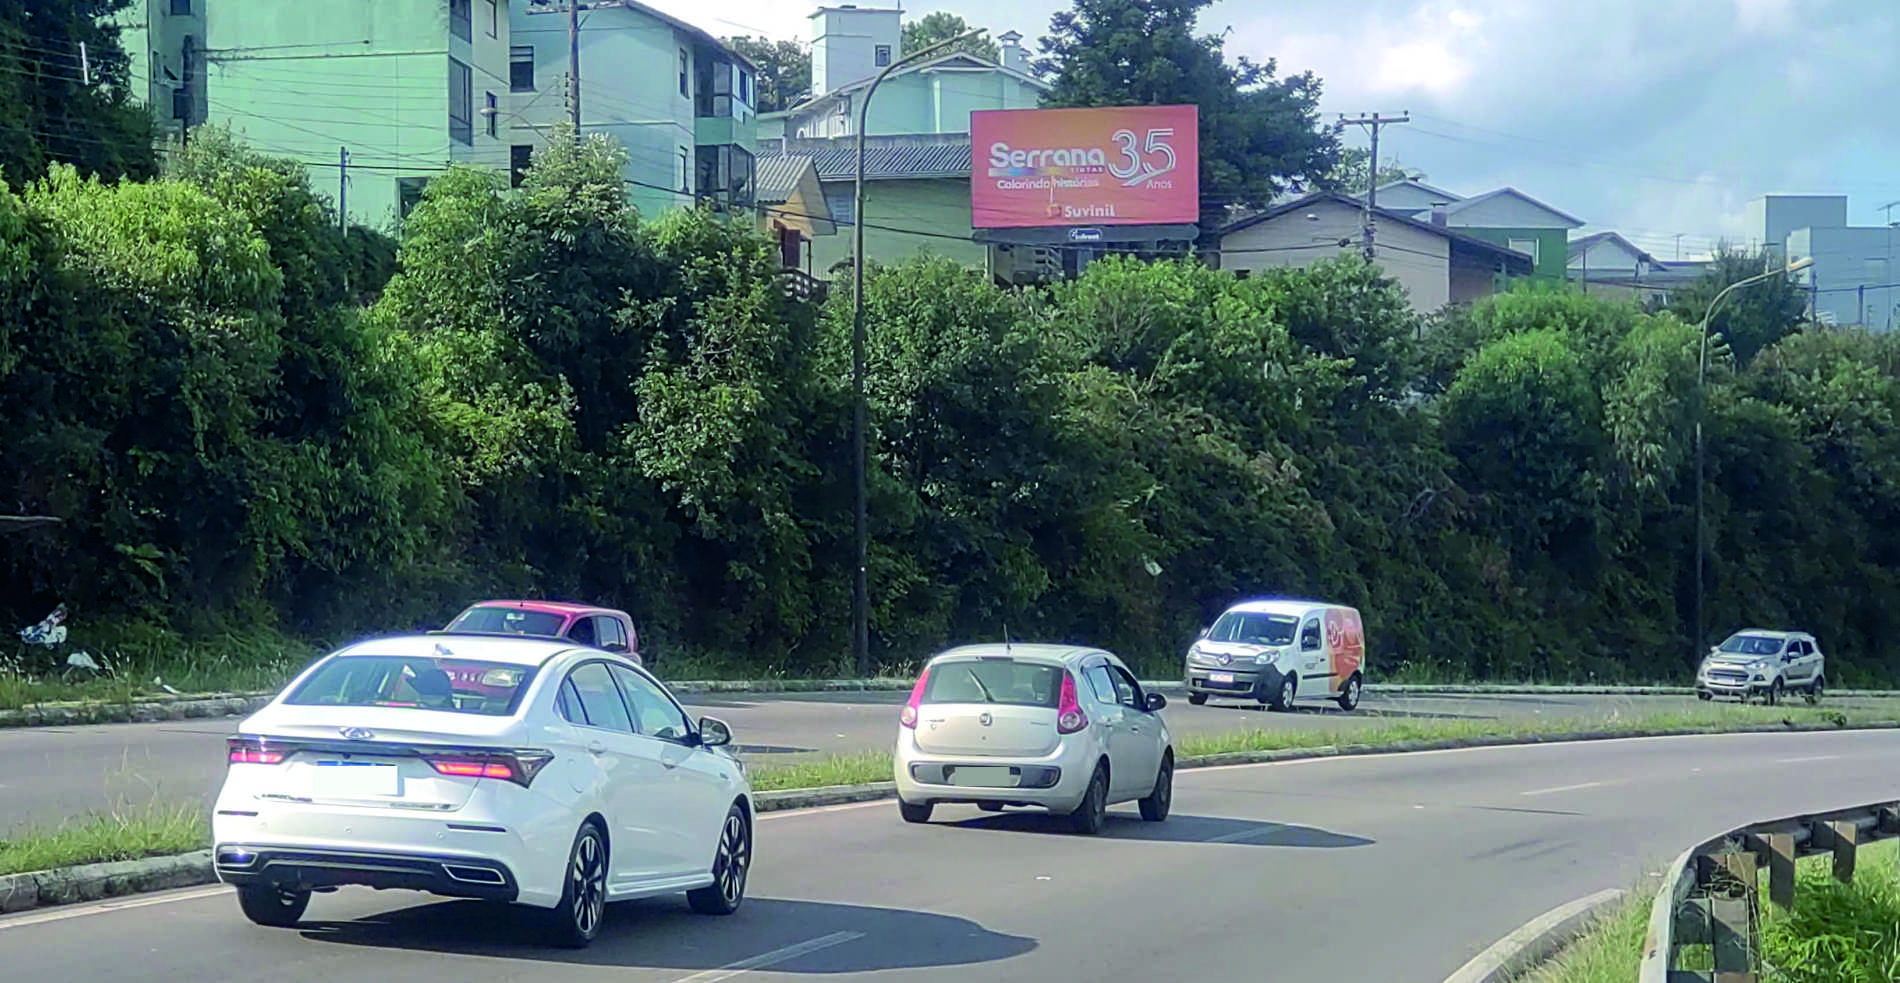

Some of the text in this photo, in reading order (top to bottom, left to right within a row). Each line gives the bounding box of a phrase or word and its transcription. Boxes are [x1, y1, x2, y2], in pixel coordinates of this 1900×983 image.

[989, 142, 1105, 168] Serrana
[1107, 128, 1176, 179] 35
[1070, 166, 1105, 174] TINTAS
[997, 178, 1050, 190] Colorindo
[1146, 180, 1172, 189] Anos
[1064, 203, 1116, 218] Suvinil
